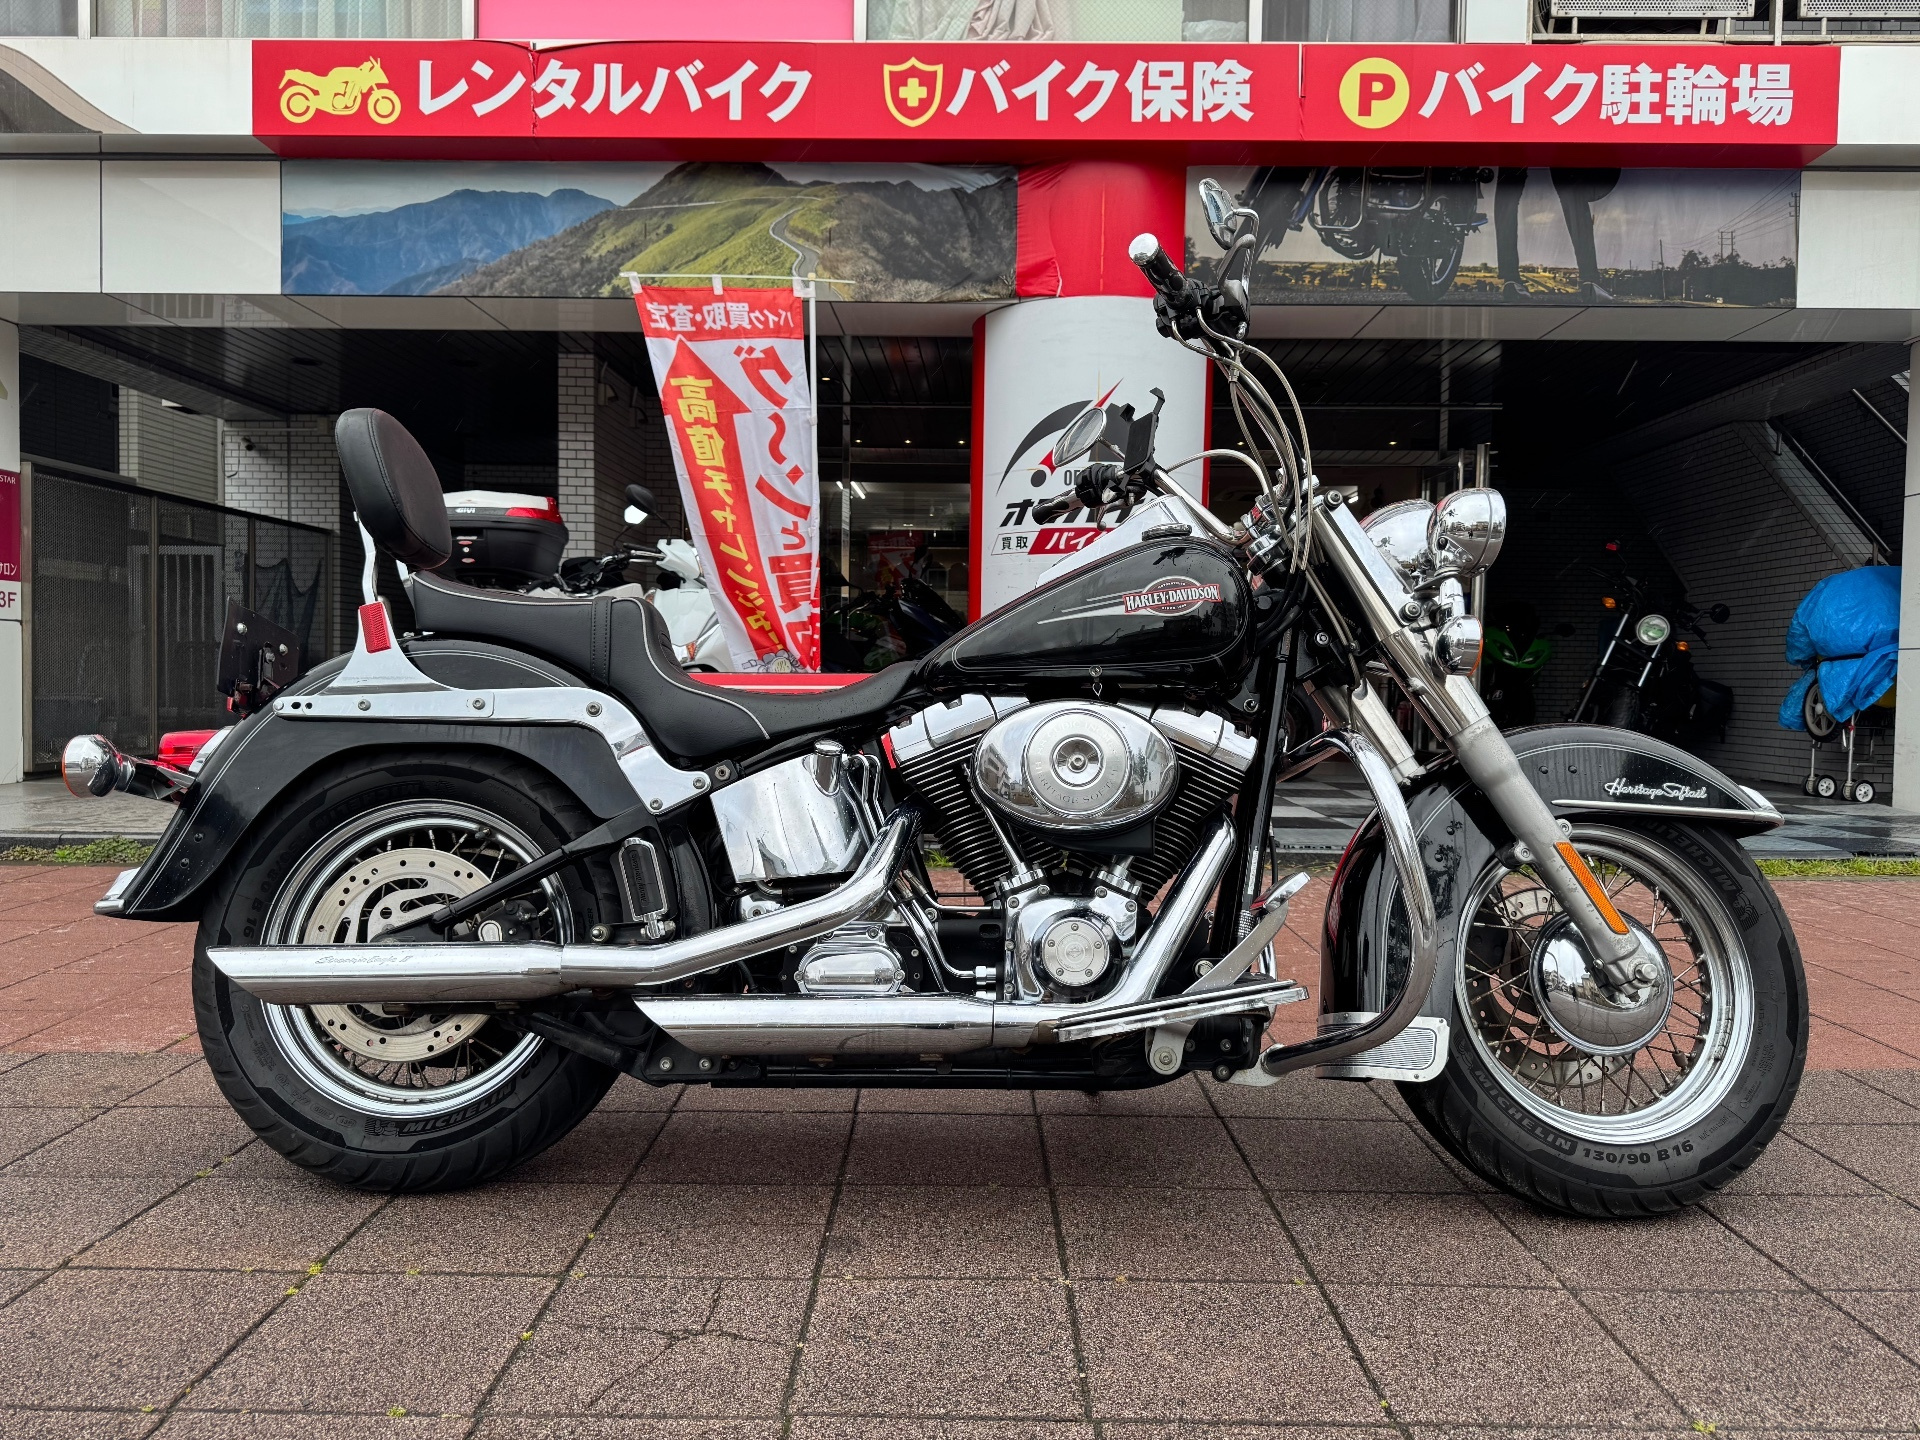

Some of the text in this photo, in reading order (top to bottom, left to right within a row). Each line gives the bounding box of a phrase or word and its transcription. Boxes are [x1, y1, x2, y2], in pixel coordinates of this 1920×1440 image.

[417, 58, 812, 123] レンタルバイク
[946, 58, 1255, 123] バイク保険
[1357, 61, 1794, 126] P バイク駐輪場
[1001, 531, 1109, 550] 買取 バイ
[1604, 778, 1663, 800] Heritage
[403, 1082, 514, 1134] MICHELIN
[1474, 1069, 1573, 1151] MICHELIN
[1583, 1147, 1651, 1165] 130/90
